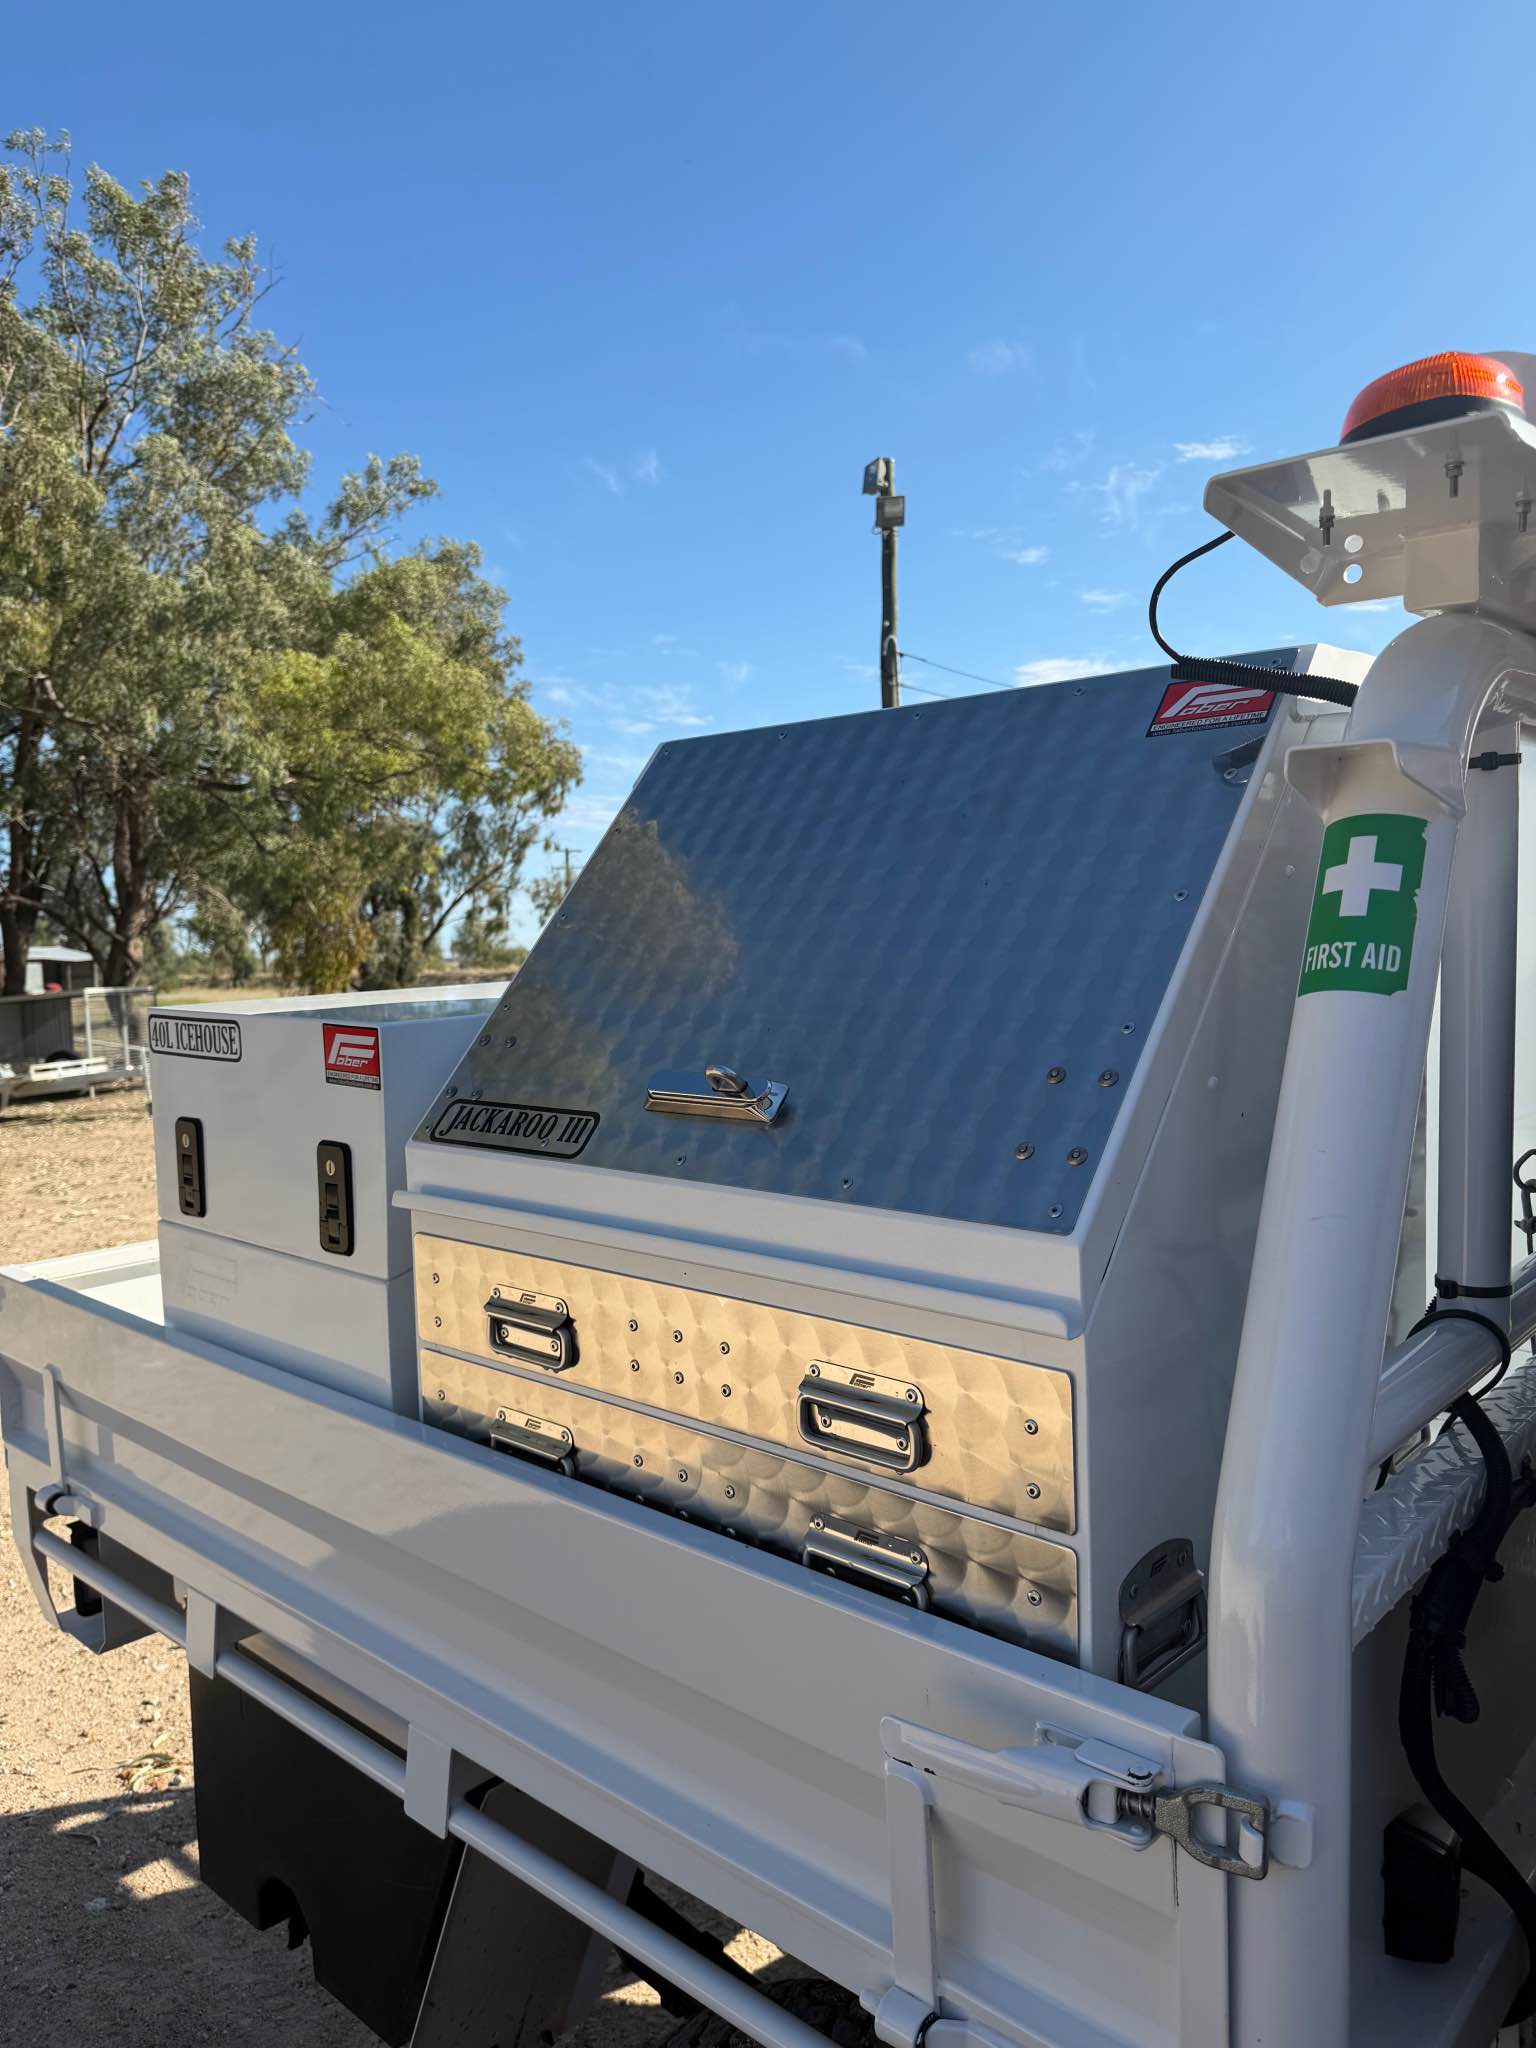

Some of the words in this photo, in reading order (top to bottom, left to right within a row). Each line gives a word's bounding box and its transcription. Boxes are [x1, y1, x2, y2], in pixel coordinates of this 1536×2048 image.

[1160, 683, 1267, 718] Faber
[1153, 719, 1203, 731] ENGINEERED
[1203, 717, 1221, 725] FOR
[1228, 712, 1266, 721] LIFETIME
[1304, 941, 1357, 974] FIRST
[1360, 942, 1402, 973] AID
[152, 1021, 174, 1050] 40L
[175, 1022, 238, 1056] ICEHOUSE
[327, 1033, 376, 1068] Faber
[439, 1105, 559, 1141] JACKAROO
[557, 1116, 592, 1144] III
